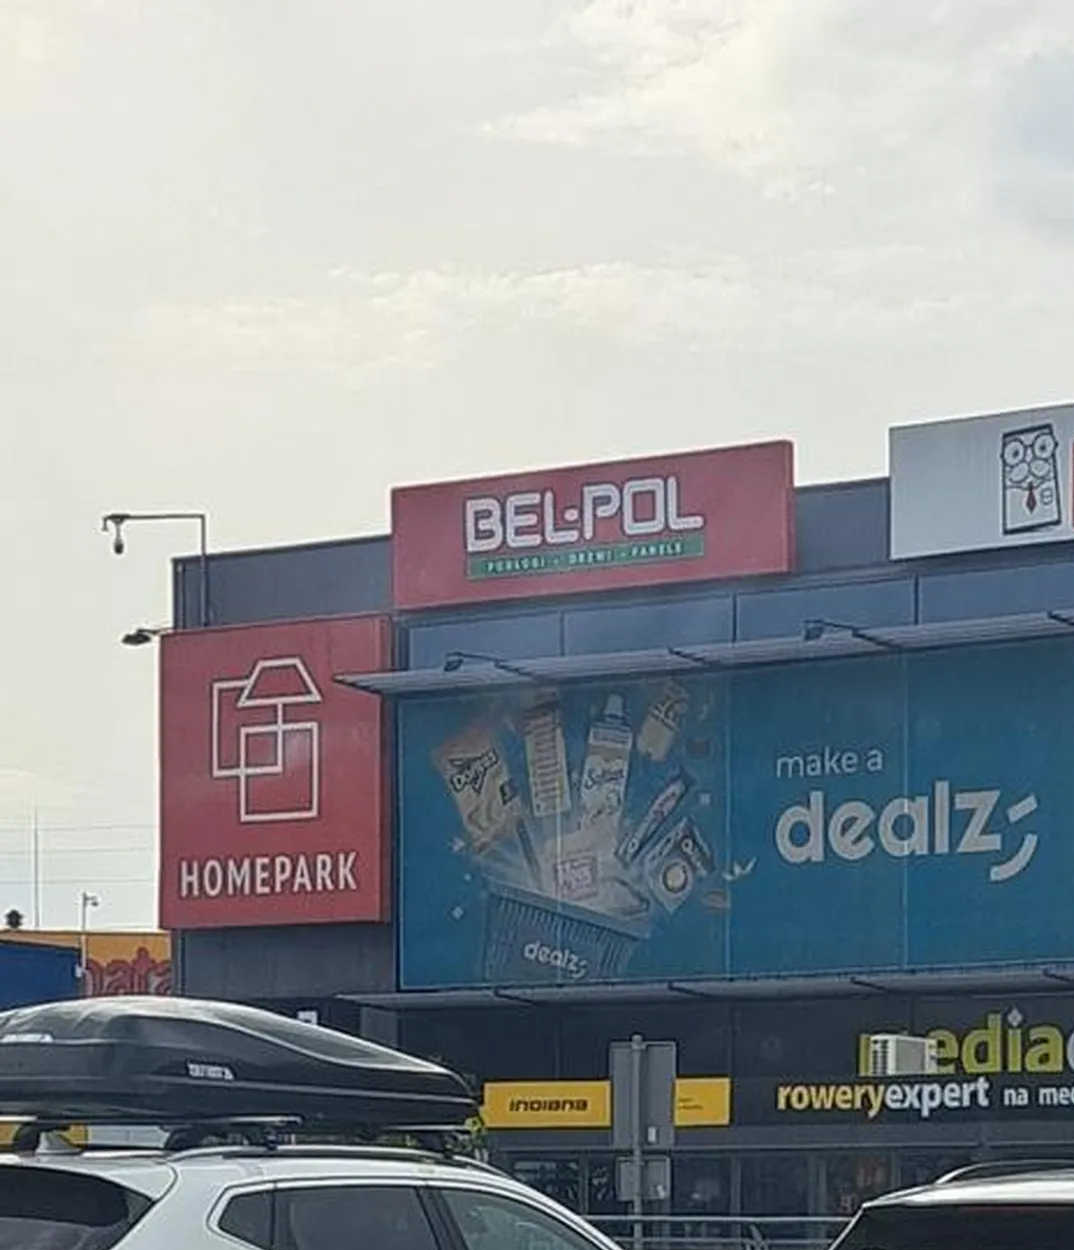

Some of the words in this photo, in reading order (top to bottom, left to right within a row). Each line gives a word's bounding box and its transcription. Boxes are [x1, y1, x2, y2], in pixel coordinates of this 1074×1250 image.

[776, 746, 858, 778] make
[867, 749, 884, 772] a
[775, 779, 1002, 865] dealz
[180, 852, 358, 898] HOMEPARK
[776, 1076, 990, 1118] roweryexpert
[1003, 1086, 1029, 1106] na
